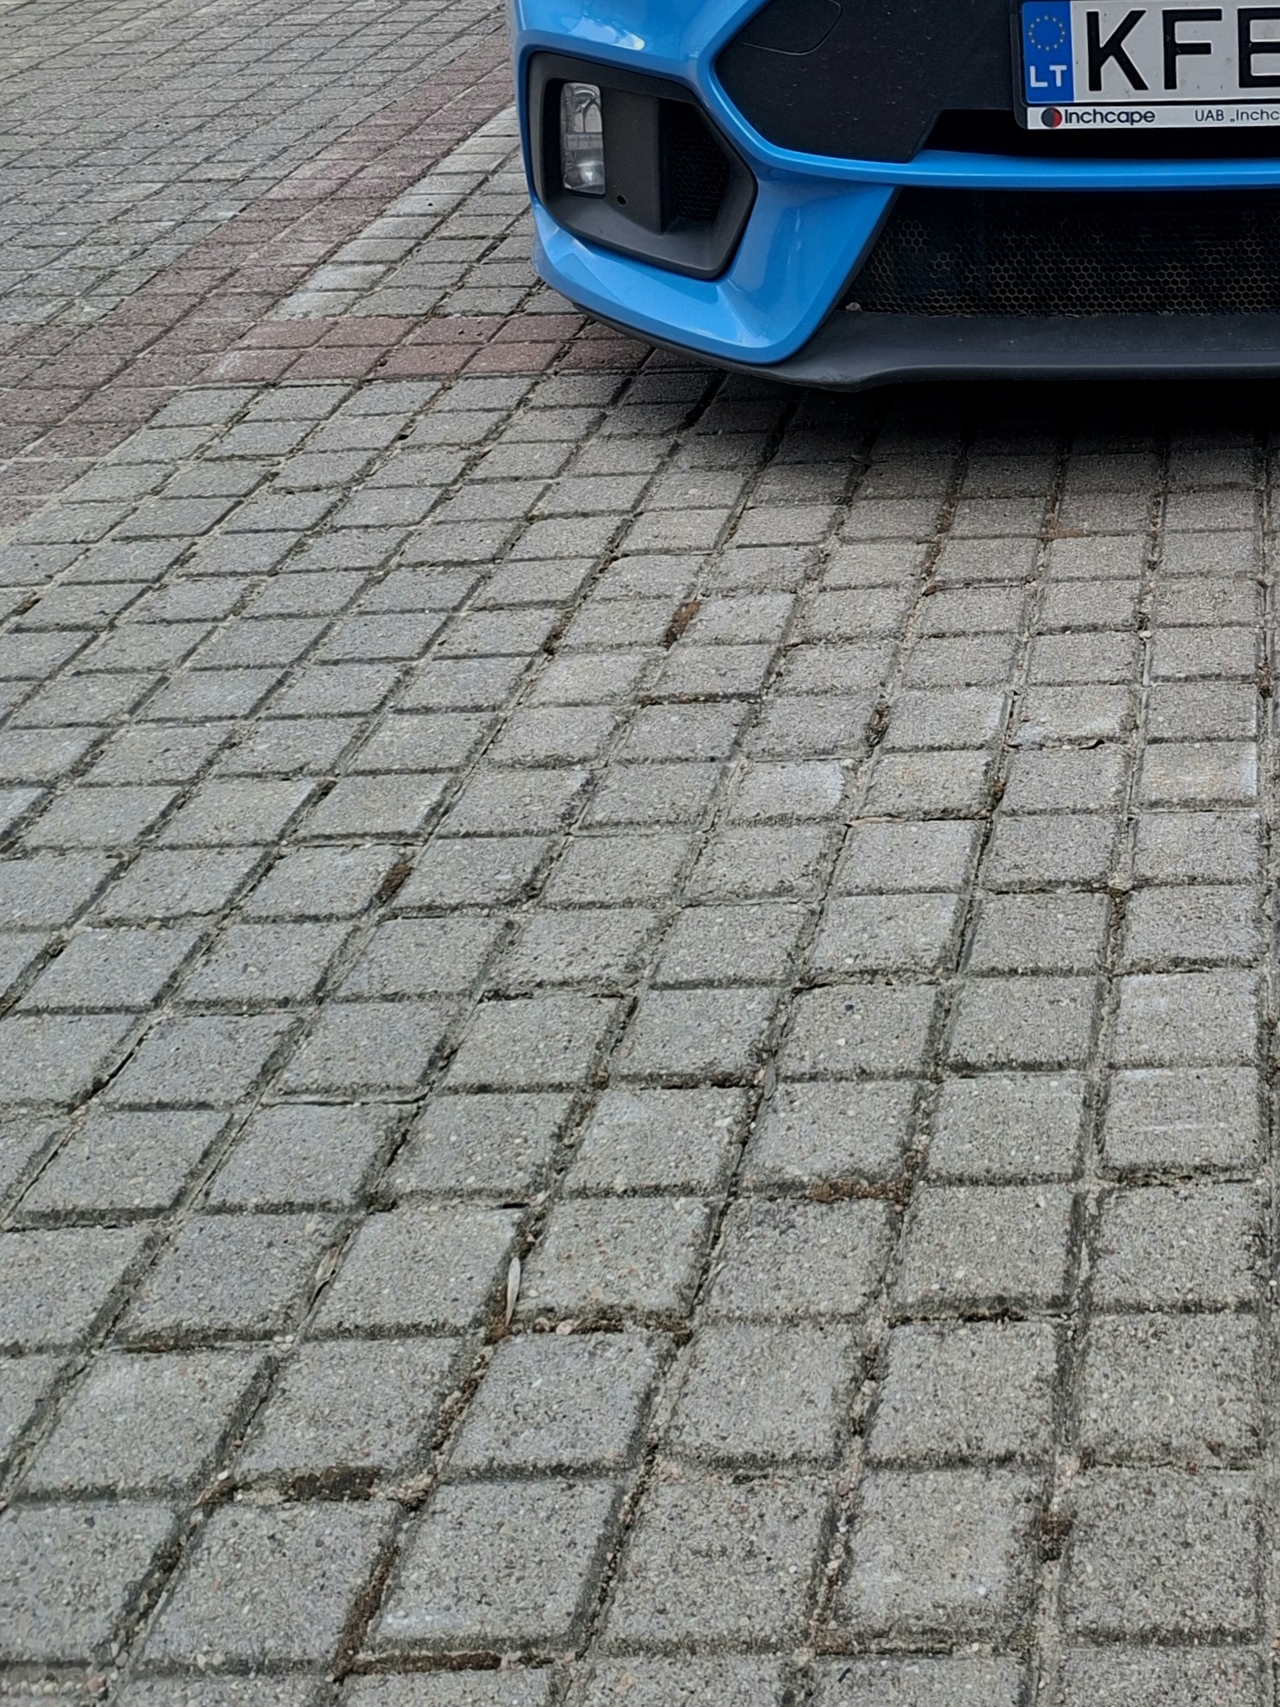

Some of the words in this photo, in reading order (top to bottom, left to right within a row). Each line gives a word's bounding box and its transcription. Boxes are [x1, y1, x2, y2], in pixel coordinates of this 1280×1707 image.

[1029, 64, 1068, 87] LT
[1064, 109, 1156, 126] Inchcape
[1194, 109, 1225, 122] UAB
